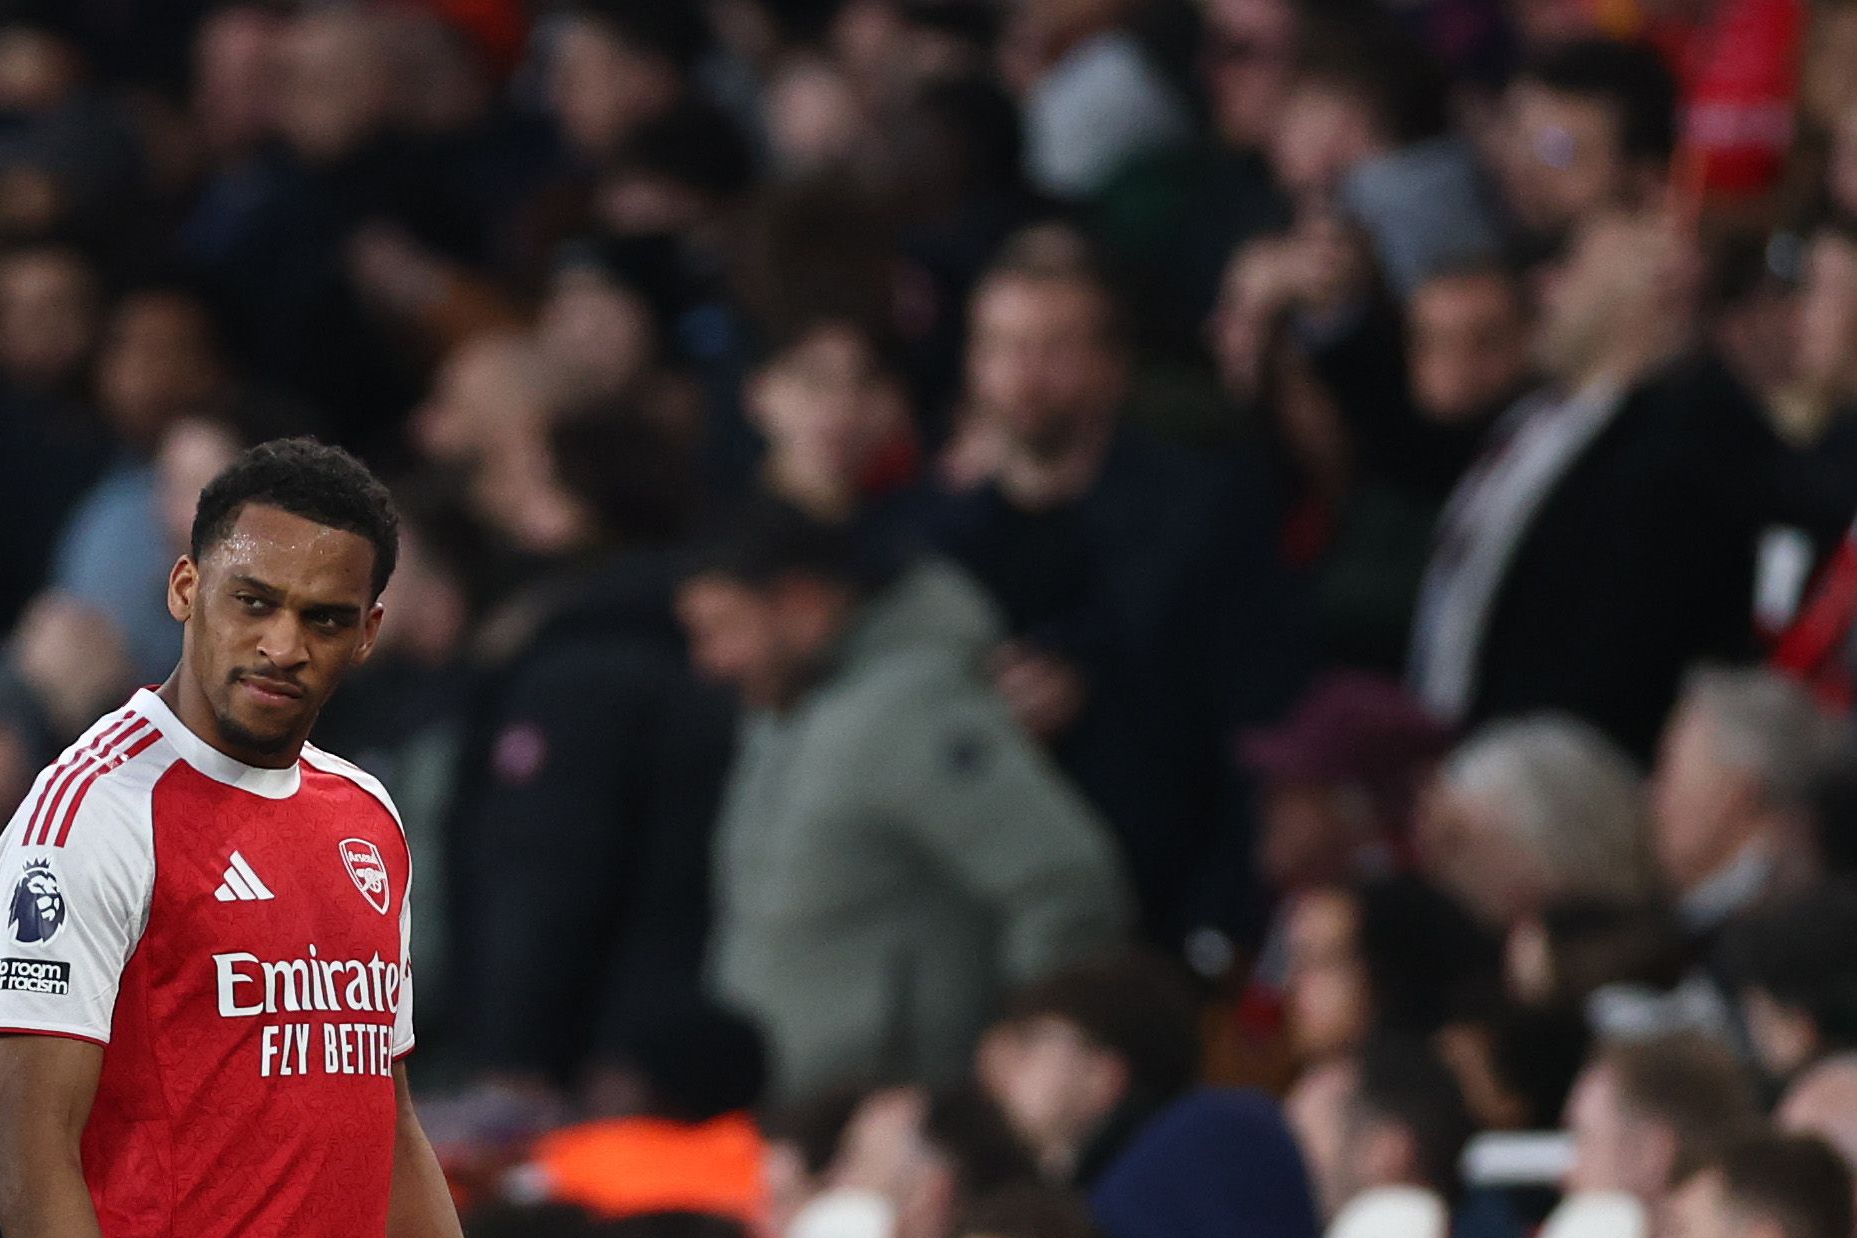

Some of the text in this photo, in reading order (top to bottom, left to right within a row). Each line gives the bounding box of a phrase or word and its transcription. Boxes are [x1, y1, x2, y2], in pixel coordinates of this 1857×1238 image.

[10, 961, 61, 979] room
[7, 976, 68, 995] racism
[261, 1023, 310, 1077] FLY
